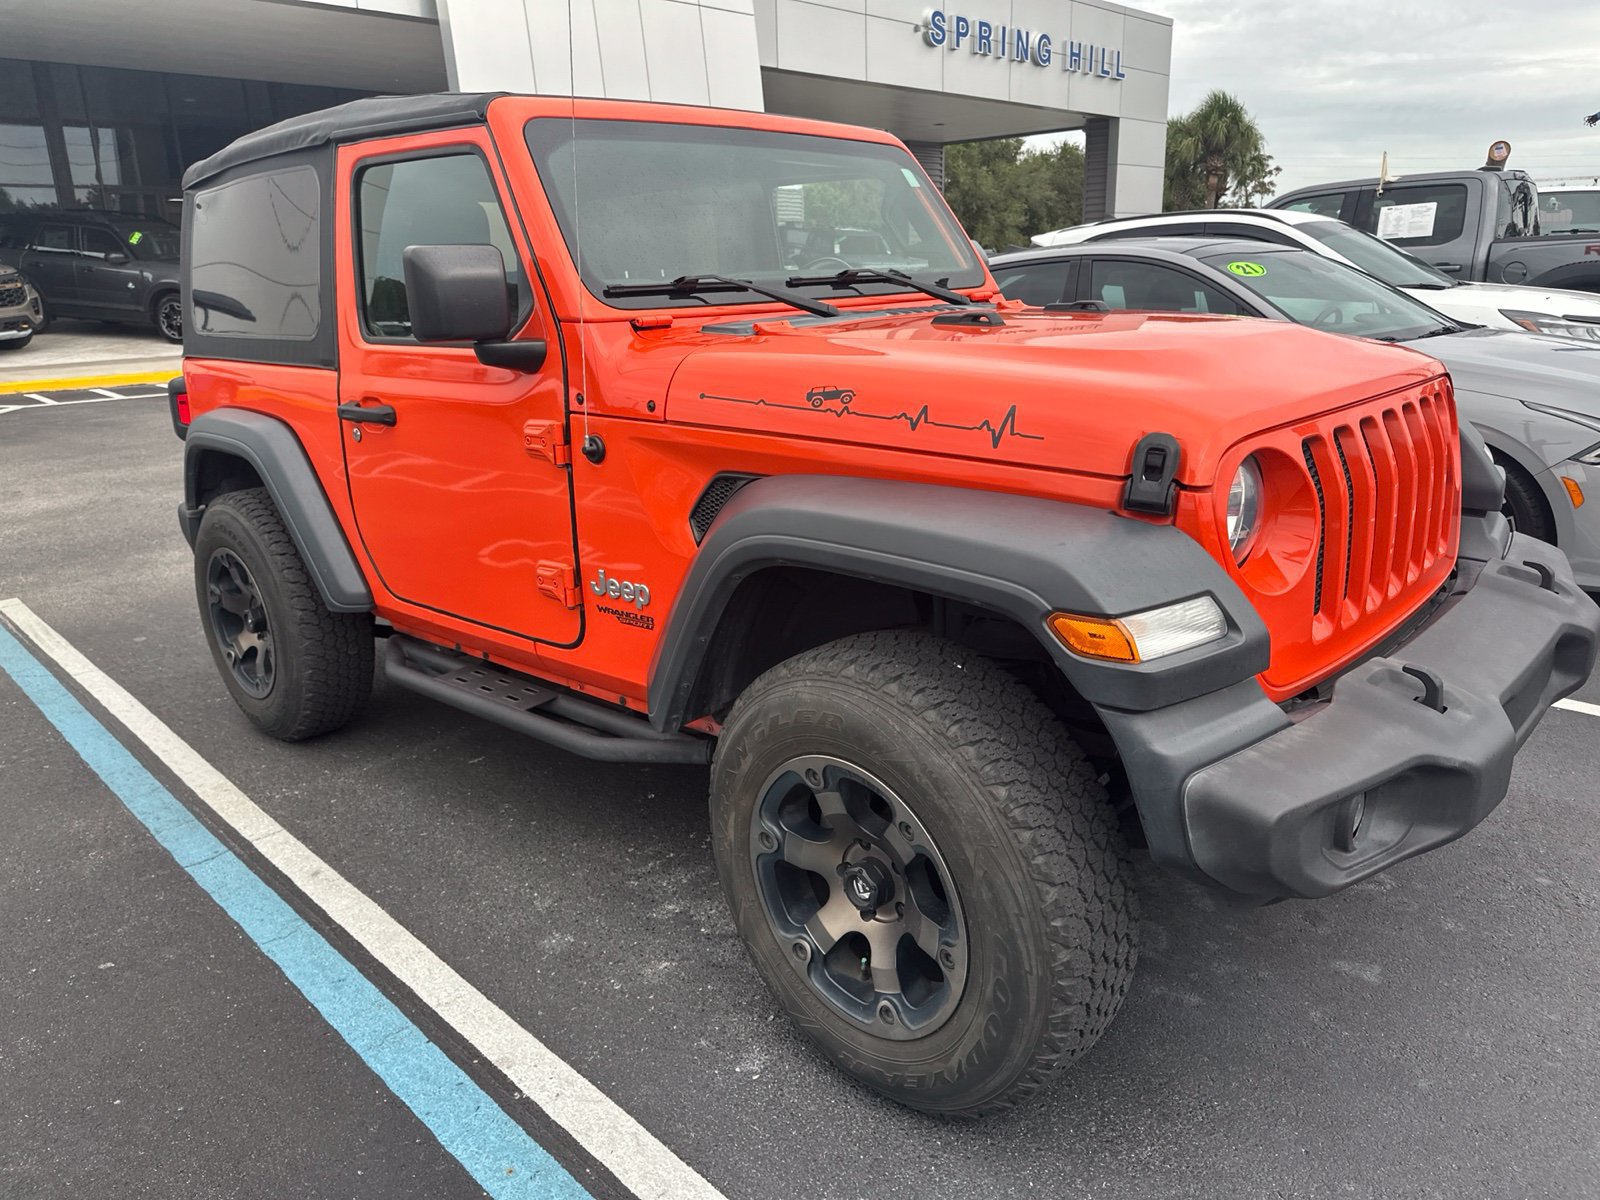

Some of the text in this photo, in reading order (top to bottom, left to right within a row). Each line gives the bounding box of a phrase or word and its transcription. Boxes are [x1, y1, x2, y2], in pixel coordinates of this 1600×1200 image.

[925, 10, 1126, 80] SPRING HILL
[1235, 263, 1260, 275] 21
[590, 569, 650, 610] Jeep
[596, 604, 654, 625] WRANGLER
